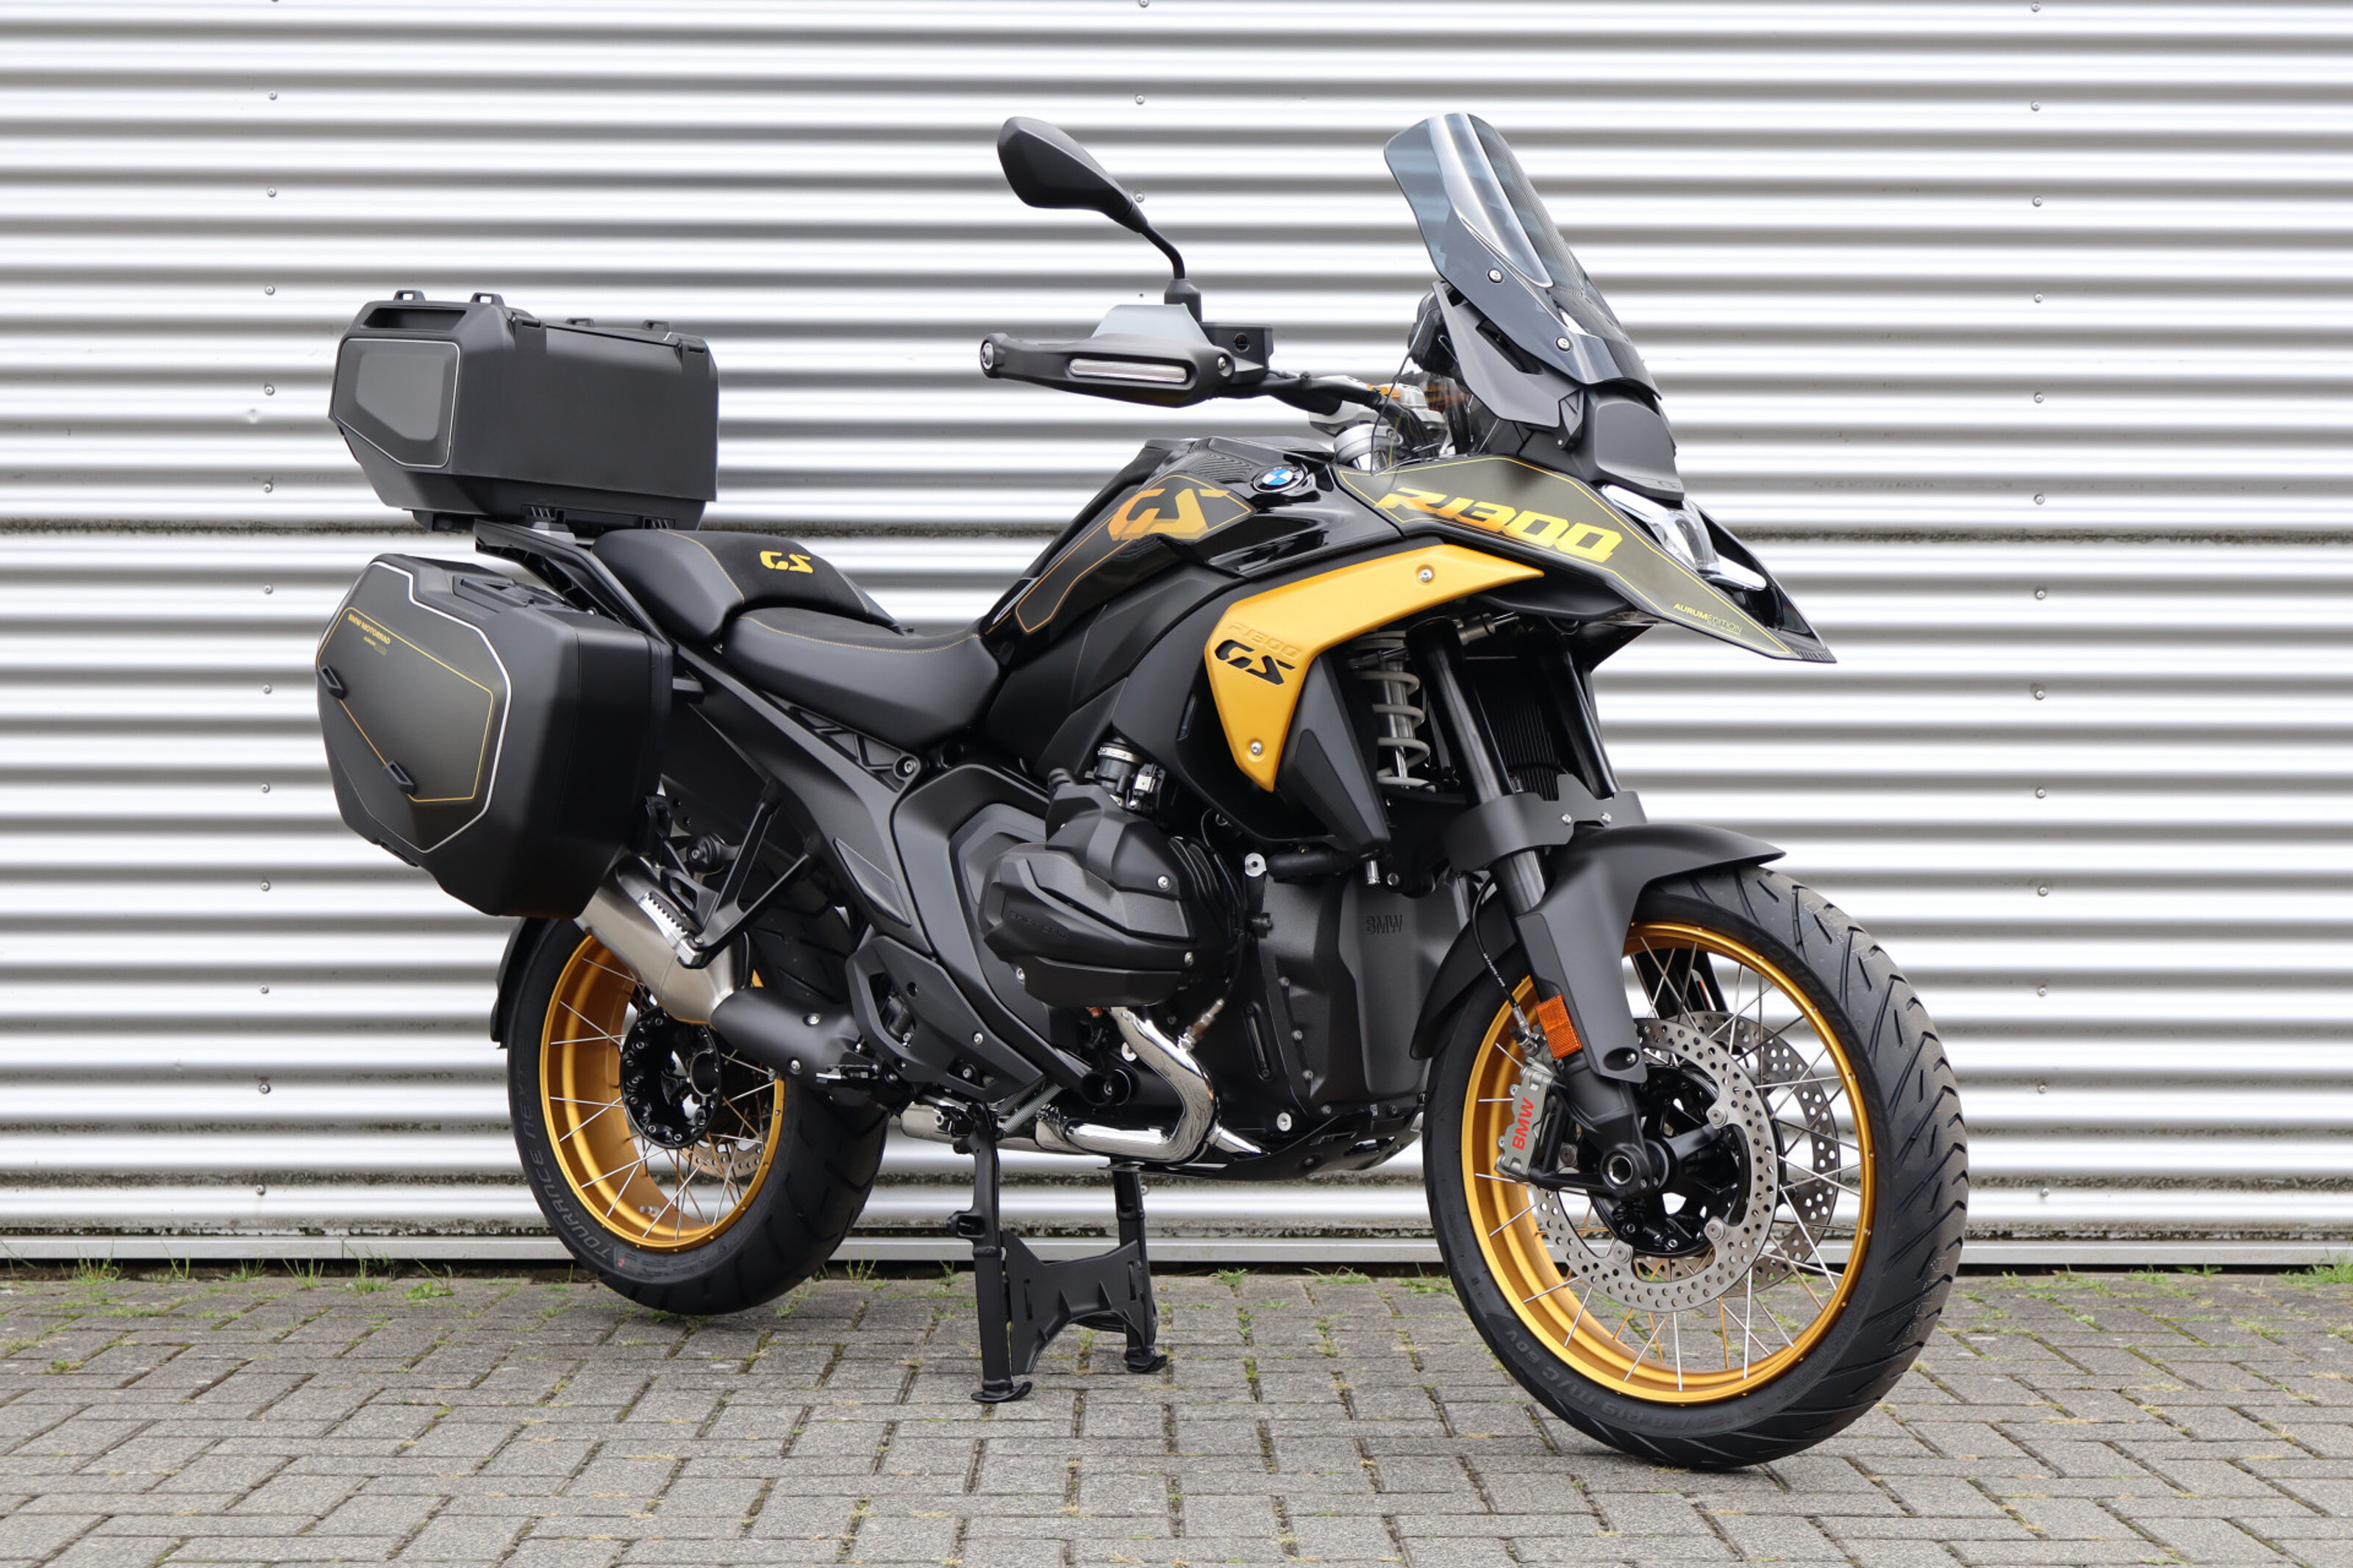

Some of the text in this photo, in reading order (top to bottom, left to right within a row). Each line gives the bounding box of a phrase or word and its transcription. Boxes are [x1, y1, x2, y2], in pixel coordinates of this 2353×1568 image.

[1107, 488, 1231, 541] GS
[1375, 487, 1623, 563] R1300
[759, 551, 814, 573] GS
[361, 621, 390, 645] MOTORRAD
[1214, 639, 1296, 685] GS
[1365, 914, 1403, 935] BMW
[1512, 1097, 1535, 1151] BMW
[529, 1148, 610, 1259] TOURANCE
